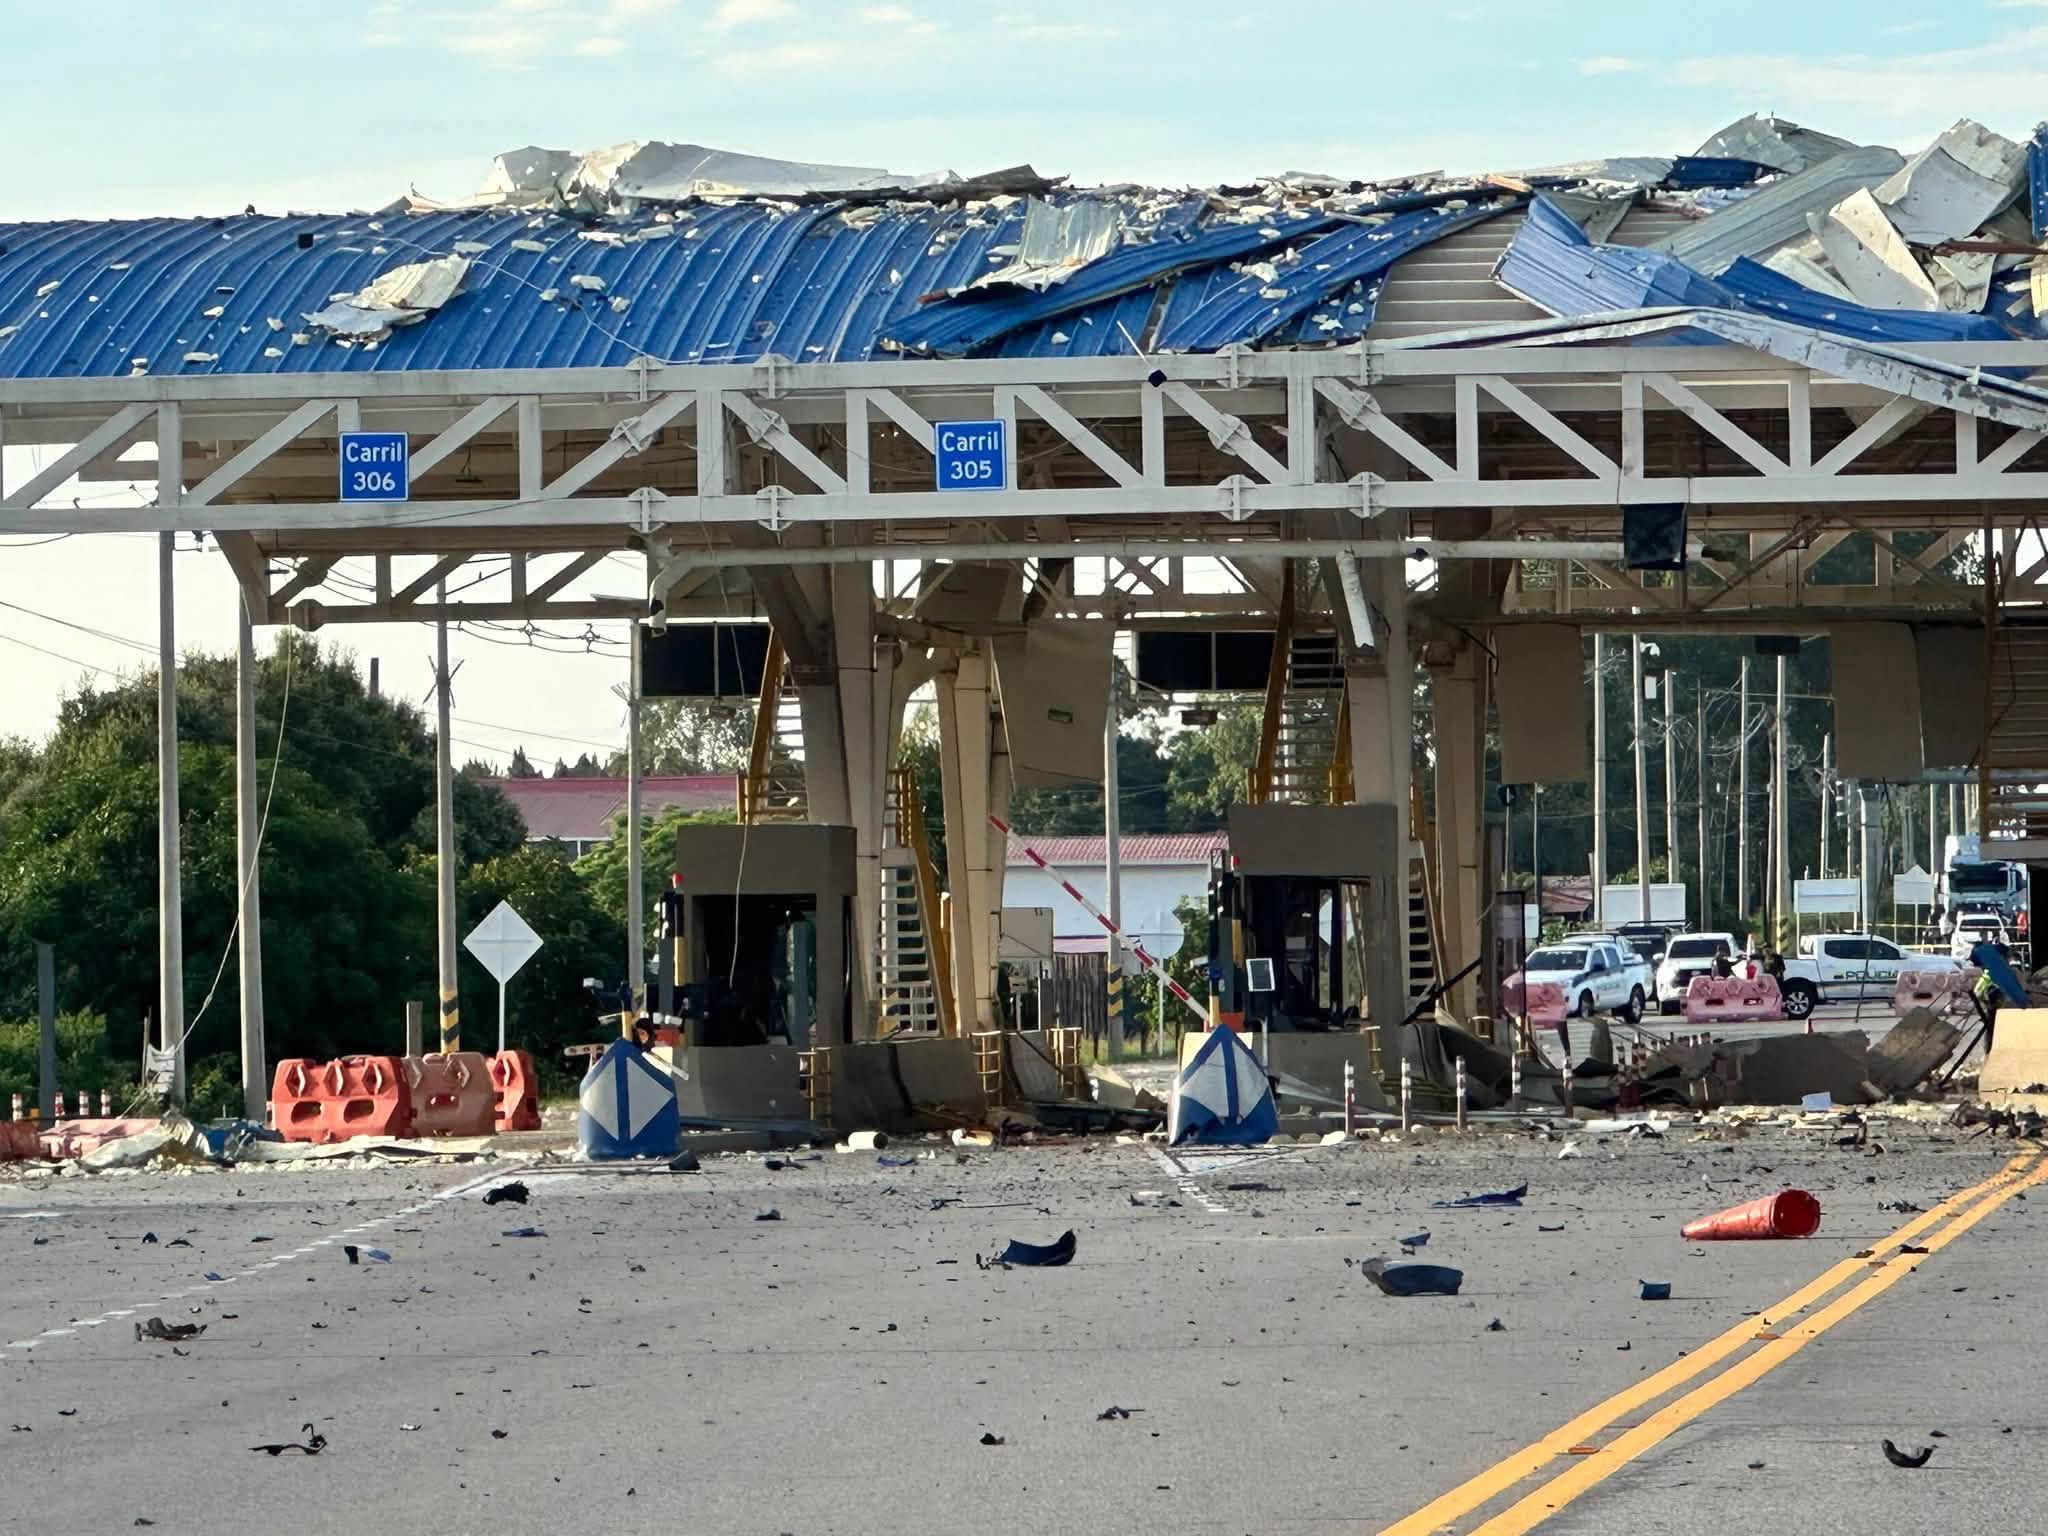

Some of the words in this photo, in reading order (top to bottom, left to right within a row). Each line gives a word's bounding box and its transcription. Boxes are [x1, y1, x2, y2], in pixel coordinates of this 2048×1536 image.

[942, 431, 999, 452] Carril
[346, 442, 402, 462] Carril
[950, 460, 992, 479] 305
[353, 471, 396, 491] 306
